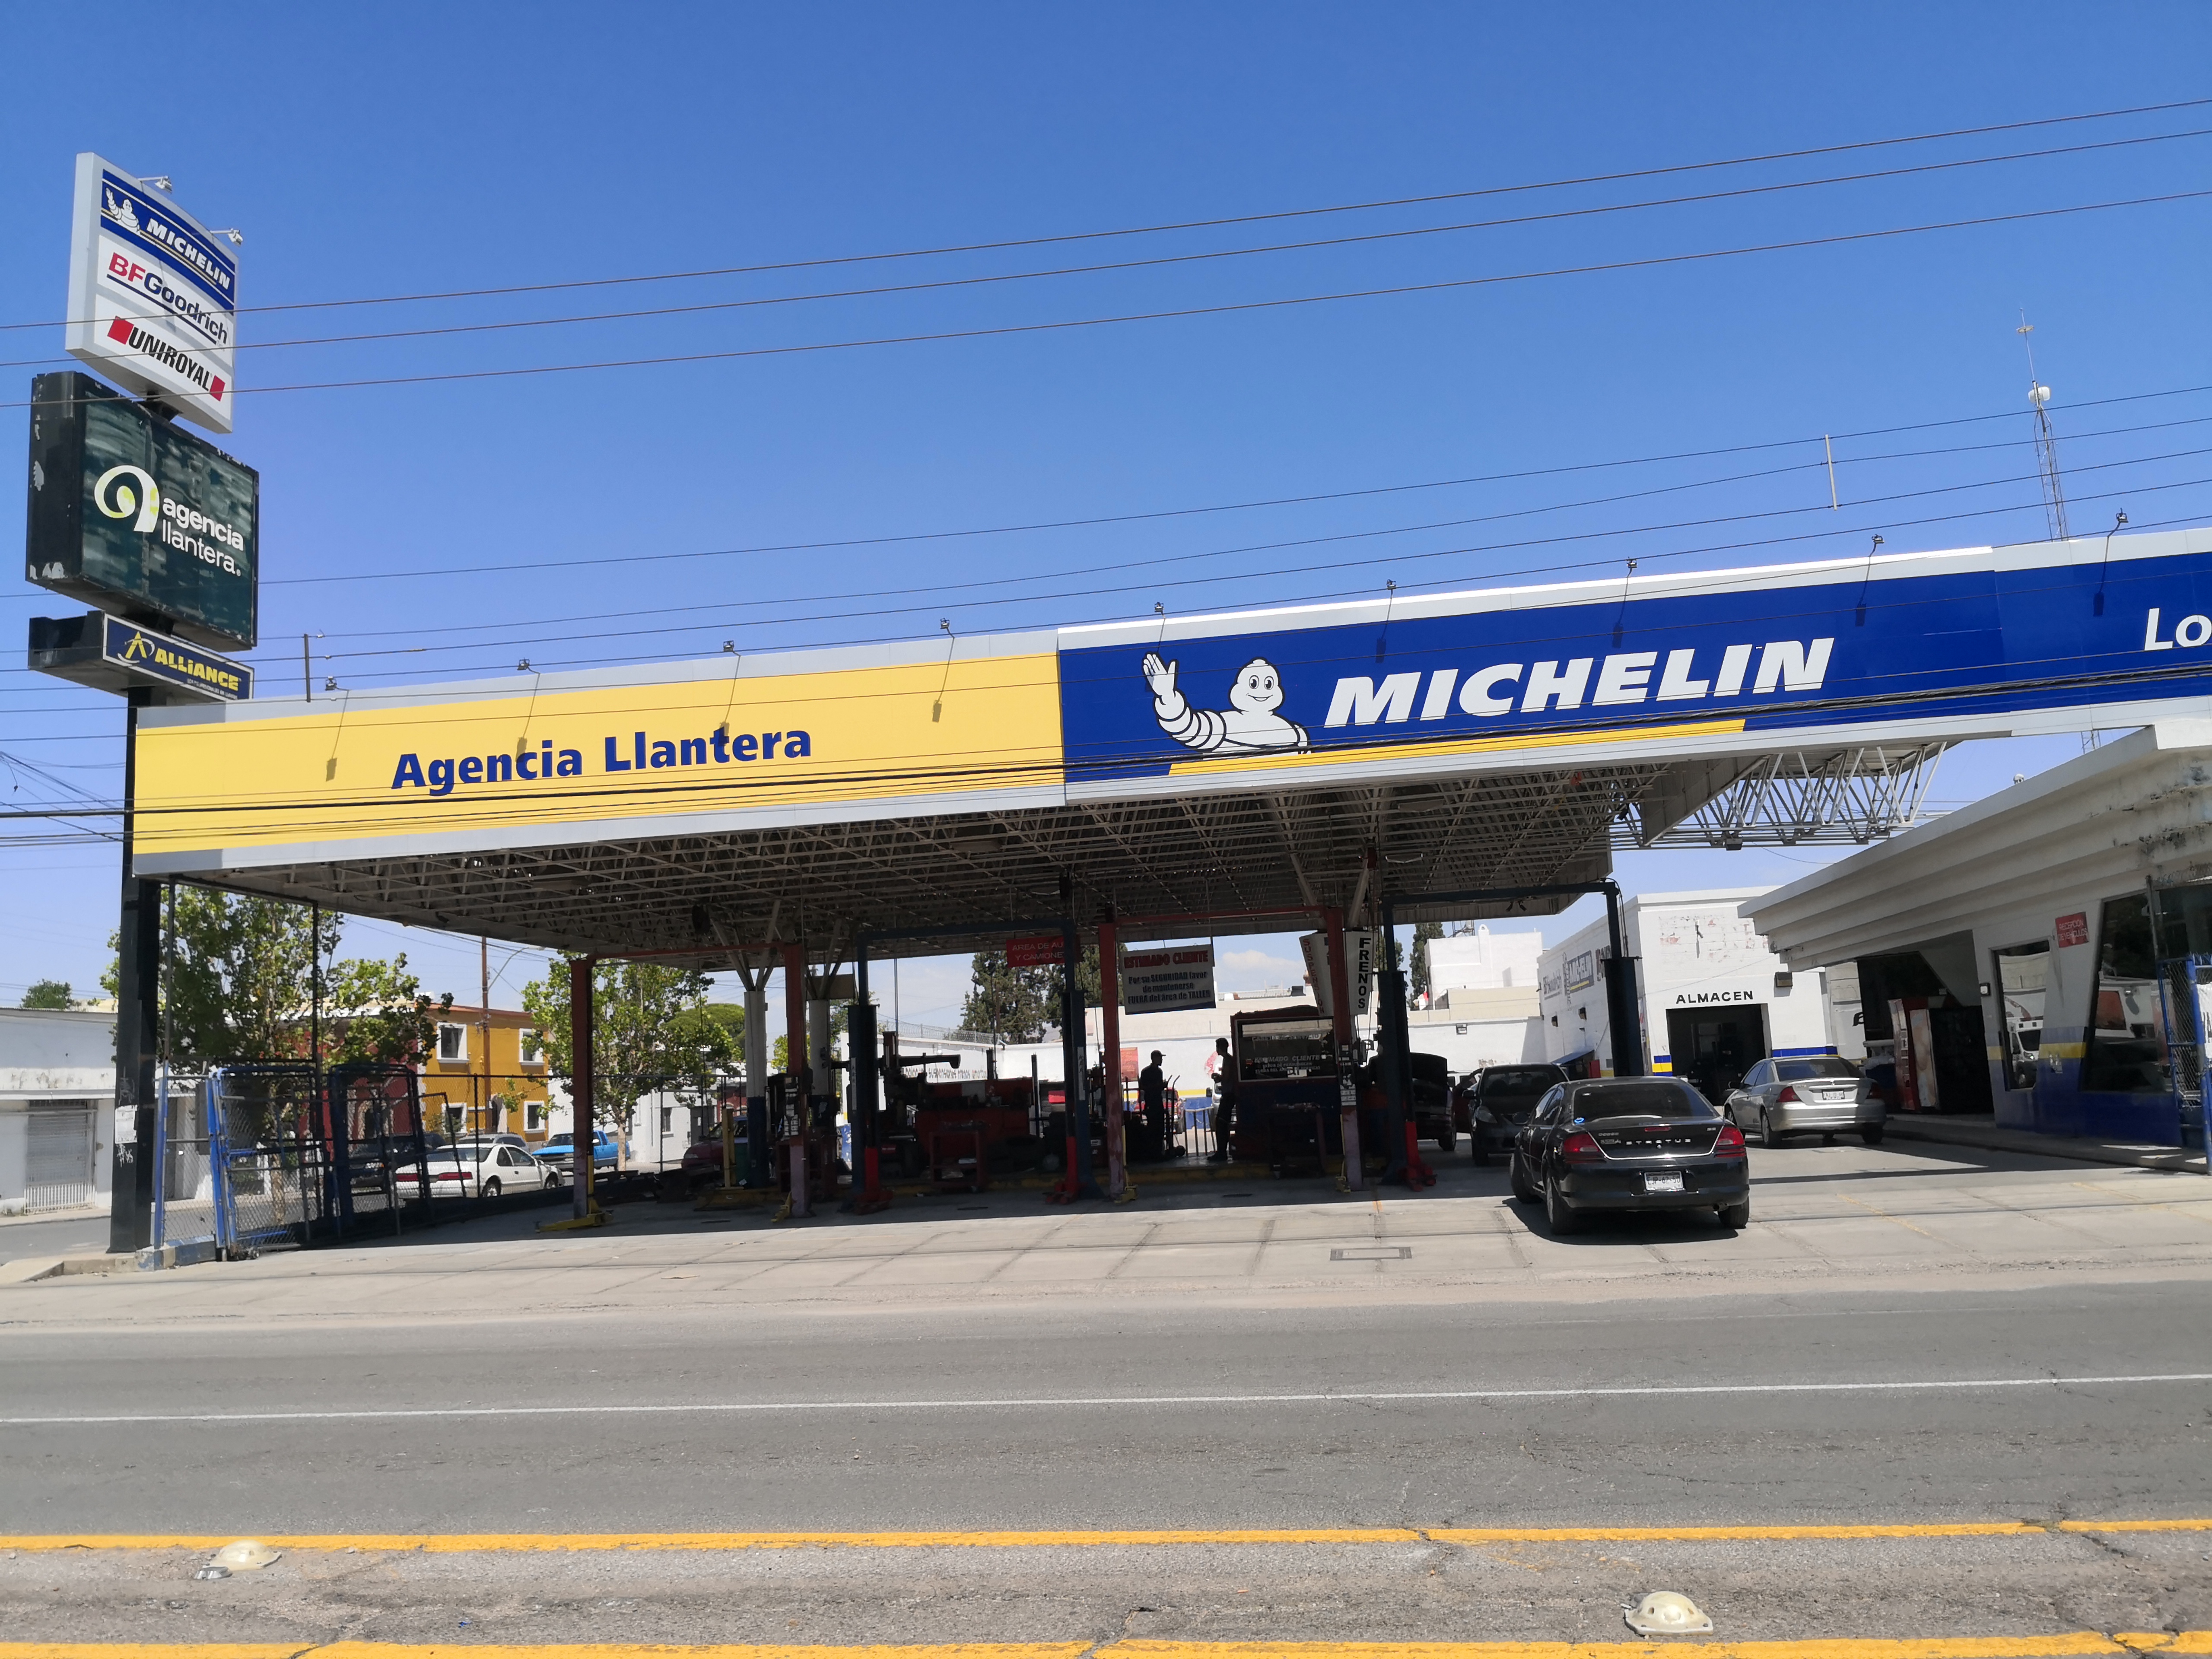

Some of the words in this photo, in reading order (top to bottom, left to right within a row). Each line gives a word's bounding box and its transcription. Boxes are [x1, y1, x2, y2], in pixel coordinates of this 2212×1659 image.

[147, 218, 230, 290] MICHELIN
[109, 252, 228, 344] BFGoodrich
[129, 327, 210, 392] UNIROYAL
[162, 498, 244, 551] agencia
[155, 648, 238, 691] ALLIANCE
[1324, 638, 1834, 728] MICHELIN
[391, 740, 582, 796] Agencia
[605, 727, 811, 772] Llantera
[1124, 953, 1170, 969] ESTIMADO
[1173, 950, 1208, 964] CLIENTE
[1150, 972, 1188, 982] SEGURIDAD
[1358, 938, 1371, 1008] FRENOS
[1676, 991, 1753, 1004] ALMACEN
